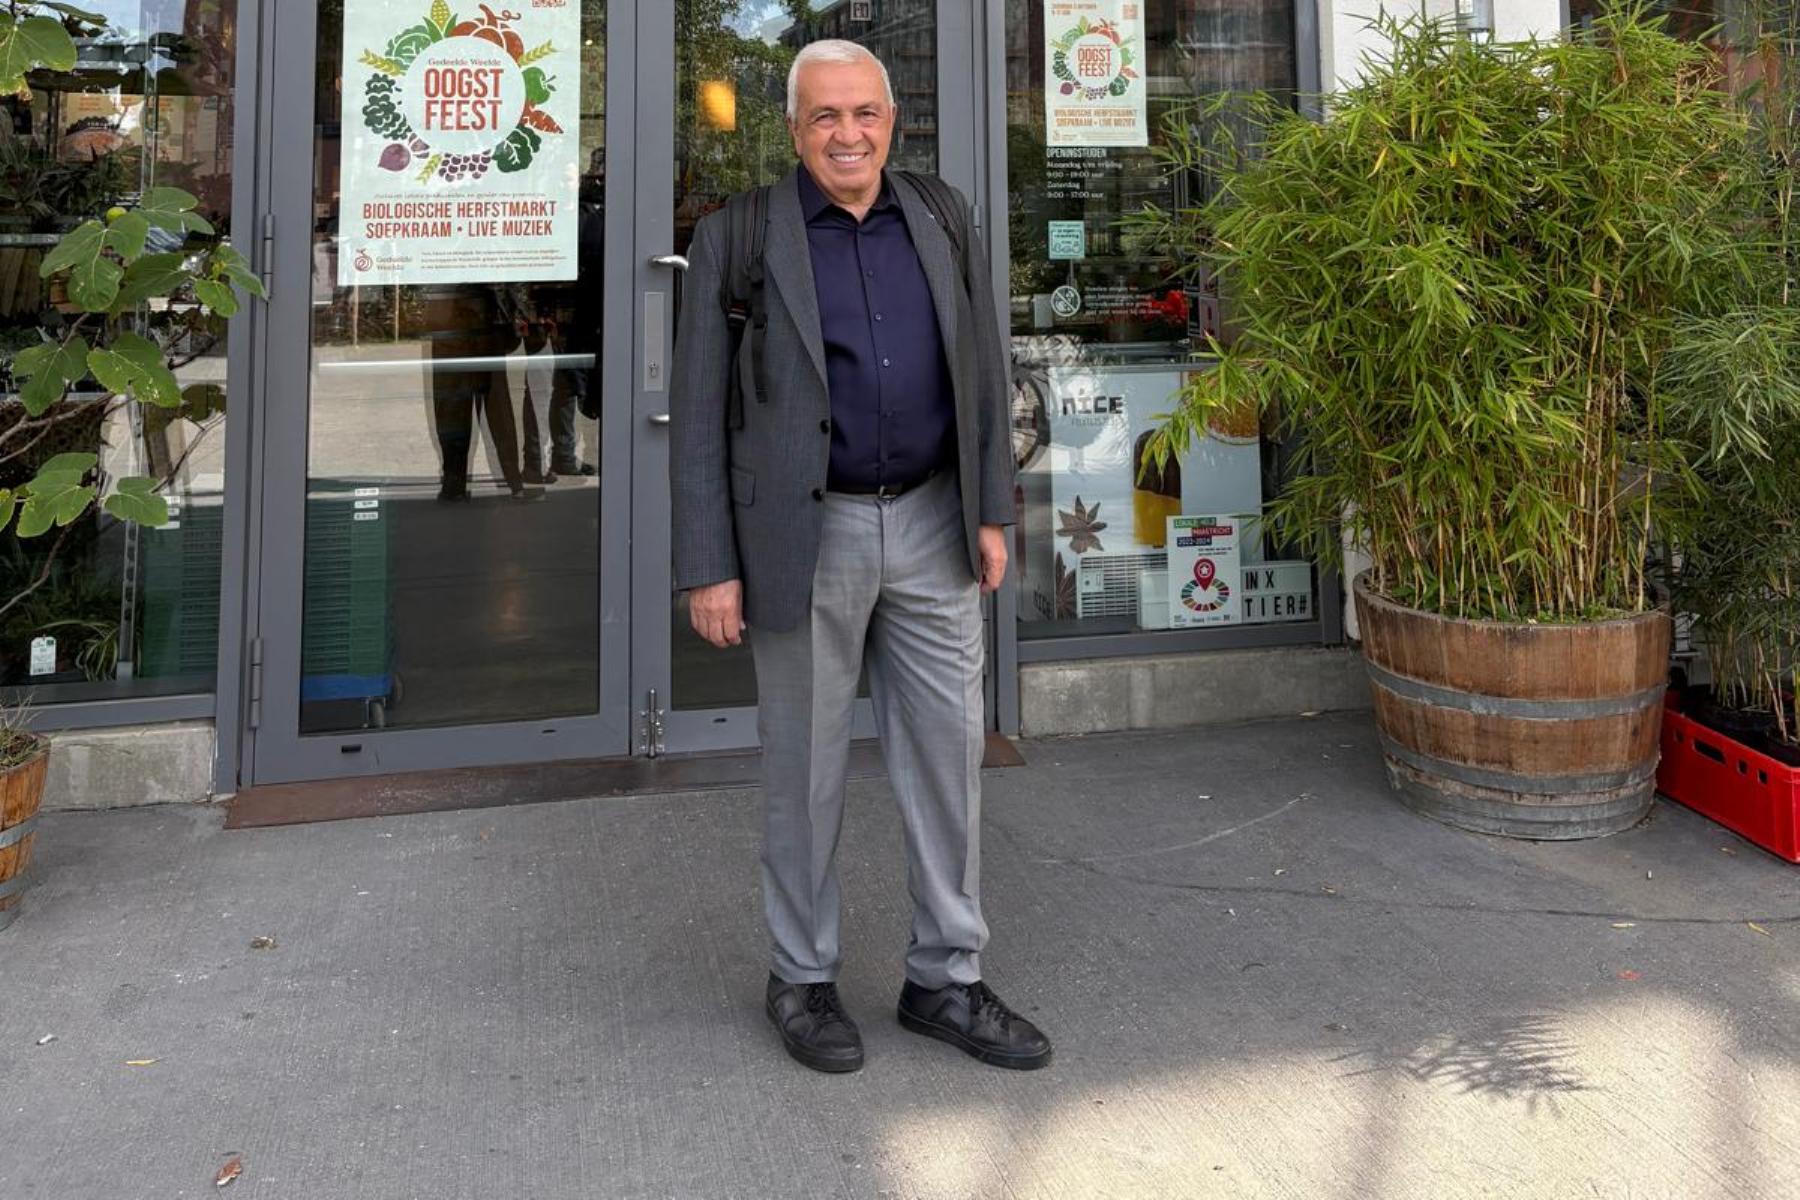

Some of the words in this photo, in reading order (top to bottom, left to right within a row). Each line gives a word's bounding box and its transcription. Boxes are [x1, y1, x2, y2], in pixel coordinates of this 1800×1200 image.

[1077, 48, 1112, 62] OOGST
[1078, 62, 1112, 77] FEEST
[425, 68, 504, 98] OOGST
[425, 99, 503, 131] FEEST
[363, 202, 452, 219] BIOLOGISCHE
[457, 201, 557, 217] HERFSTMARKT
[366, 221, 452, 238] SOEPKRAAM
[468, 221, 497, 237] LIVE
[502, 220, 553, 236] MUZIEK
